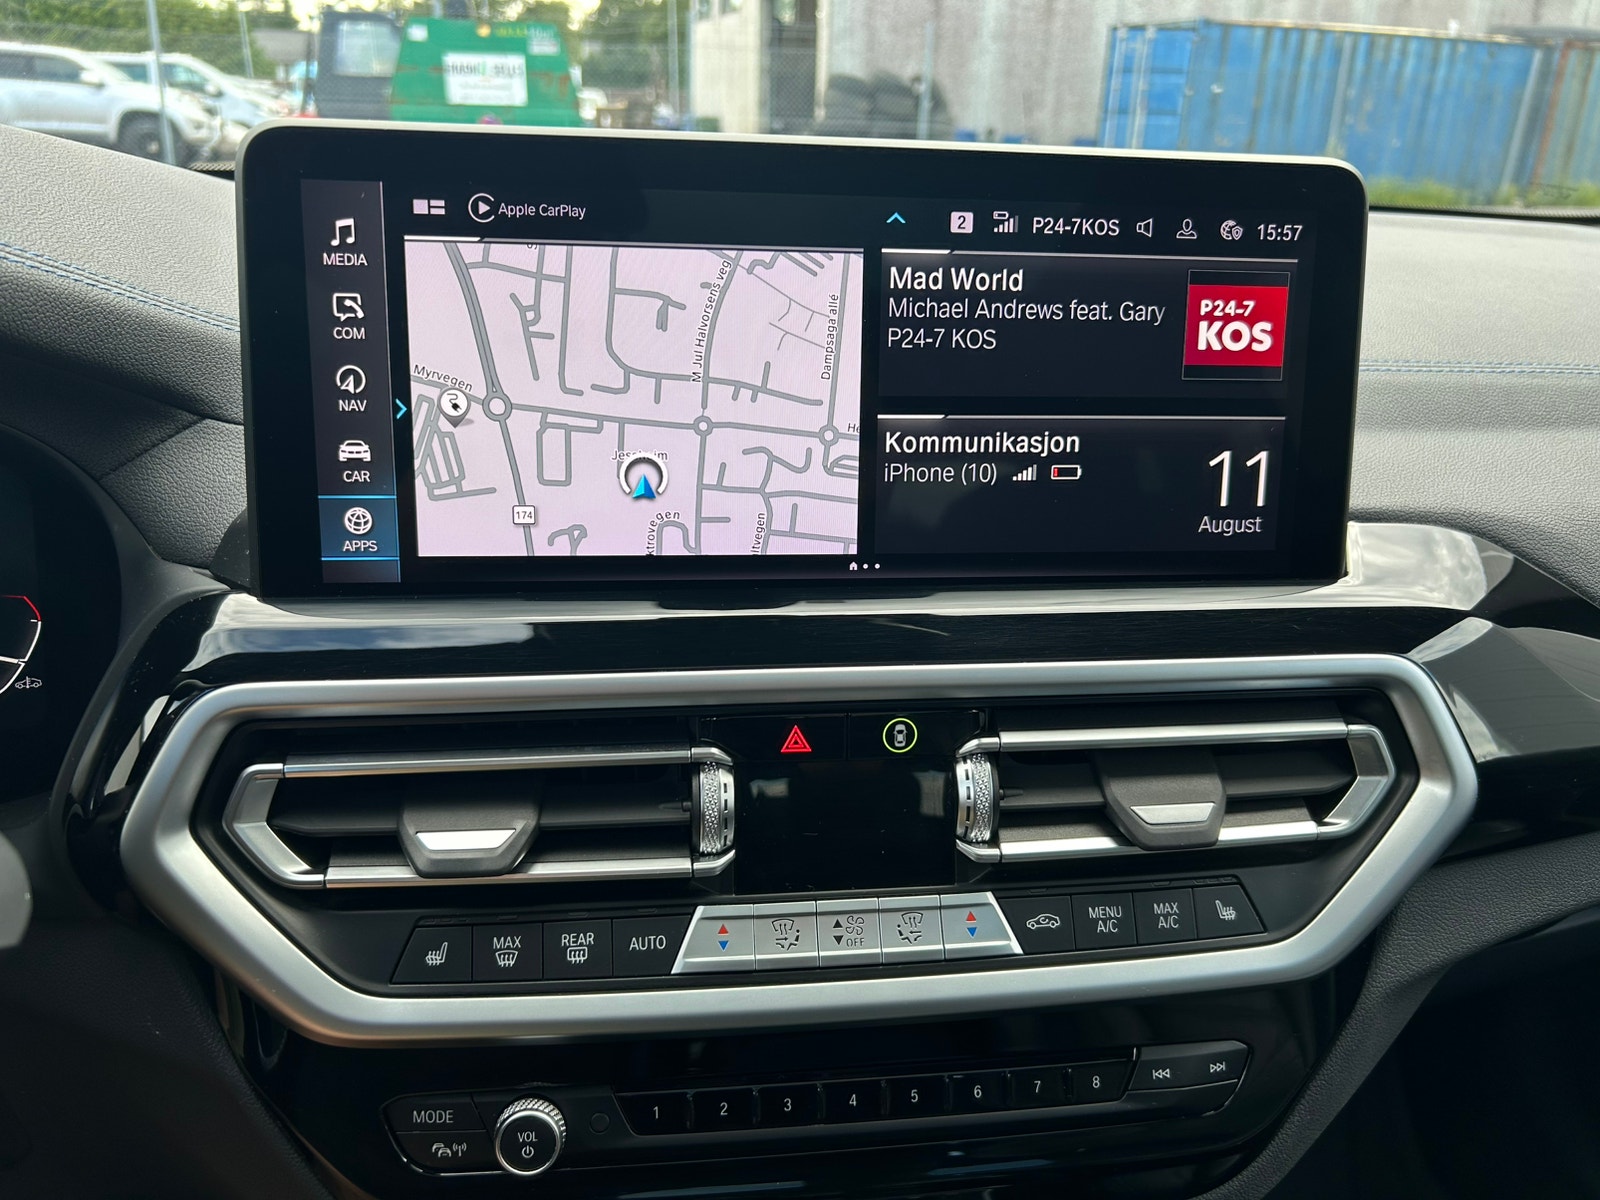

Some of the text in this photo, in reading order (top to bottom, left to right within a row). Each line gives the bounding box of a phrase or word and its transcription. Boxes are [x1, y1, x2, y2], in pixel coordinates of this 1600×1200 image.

[498, 202, 586, 220] Apple CarPlay
[957, 215, 966, 230] 2
[1032, 218, 1120, 236] P24-7KOS
[1257, 224, 1303, 242] 15:57
[322, 252, 368, 268] MEDIA
[889, 266, 1023, 291] Mad World
[888, 298, 1166, 326] Michael Andrews feat. Gary
[1200, 299, 1255, 317] P24-7
[692, 259, 732, 383] M Jul Halvorsens veg
[333, 327, 366, 340] COM
[820, 293, 838, 380] Dampsaga allé
[887, 328, 997, 349] P24-7 KOS
[1197, 321, 1273, 352] KOS
[413, 364, 473, 391] Myrvegen
[338, 399, 367, 412] NAV
[884, 431, 1080, 456] Kommunikasjon
[343, 470, 371, 483] CAR
[883, 463, 998, 486] iPhone (10)
[1208, 450, 1270, 507] 11
[515, 510, 533, 520] 174
[1198, 515, 1263, 536] August
[343, 540, 378, 552] APPS
[1088, 906, 1122, 919] MENU
[1153, 902, 1179, 915] MAX
[1097, 920, 1119, 933] A/C
[1158, 915, 1179, 929] A/C
[493, 936, 522, 950] MAX
[561, 932, 595, 947] REAR
[629, 935, 667, 951] AUTO
[846, 937, 865, 949] OFF
[1033, 1080, 1041, 1094] 7
[1092, 1075, 1100, 1089] 8
[848, 1093, 857, 1107] 4
[910, 1089, 918, 1103] 5
[973, 1086, 982, 1099] 6
[652, 1105, 660, 1119] 1
[720, 1102, 729, 1117] 2
[783, 1097, 792, 1113] 3
[412, 1109, 454, 1124] MODE
[517, 1131, 538, 1143] VOL
